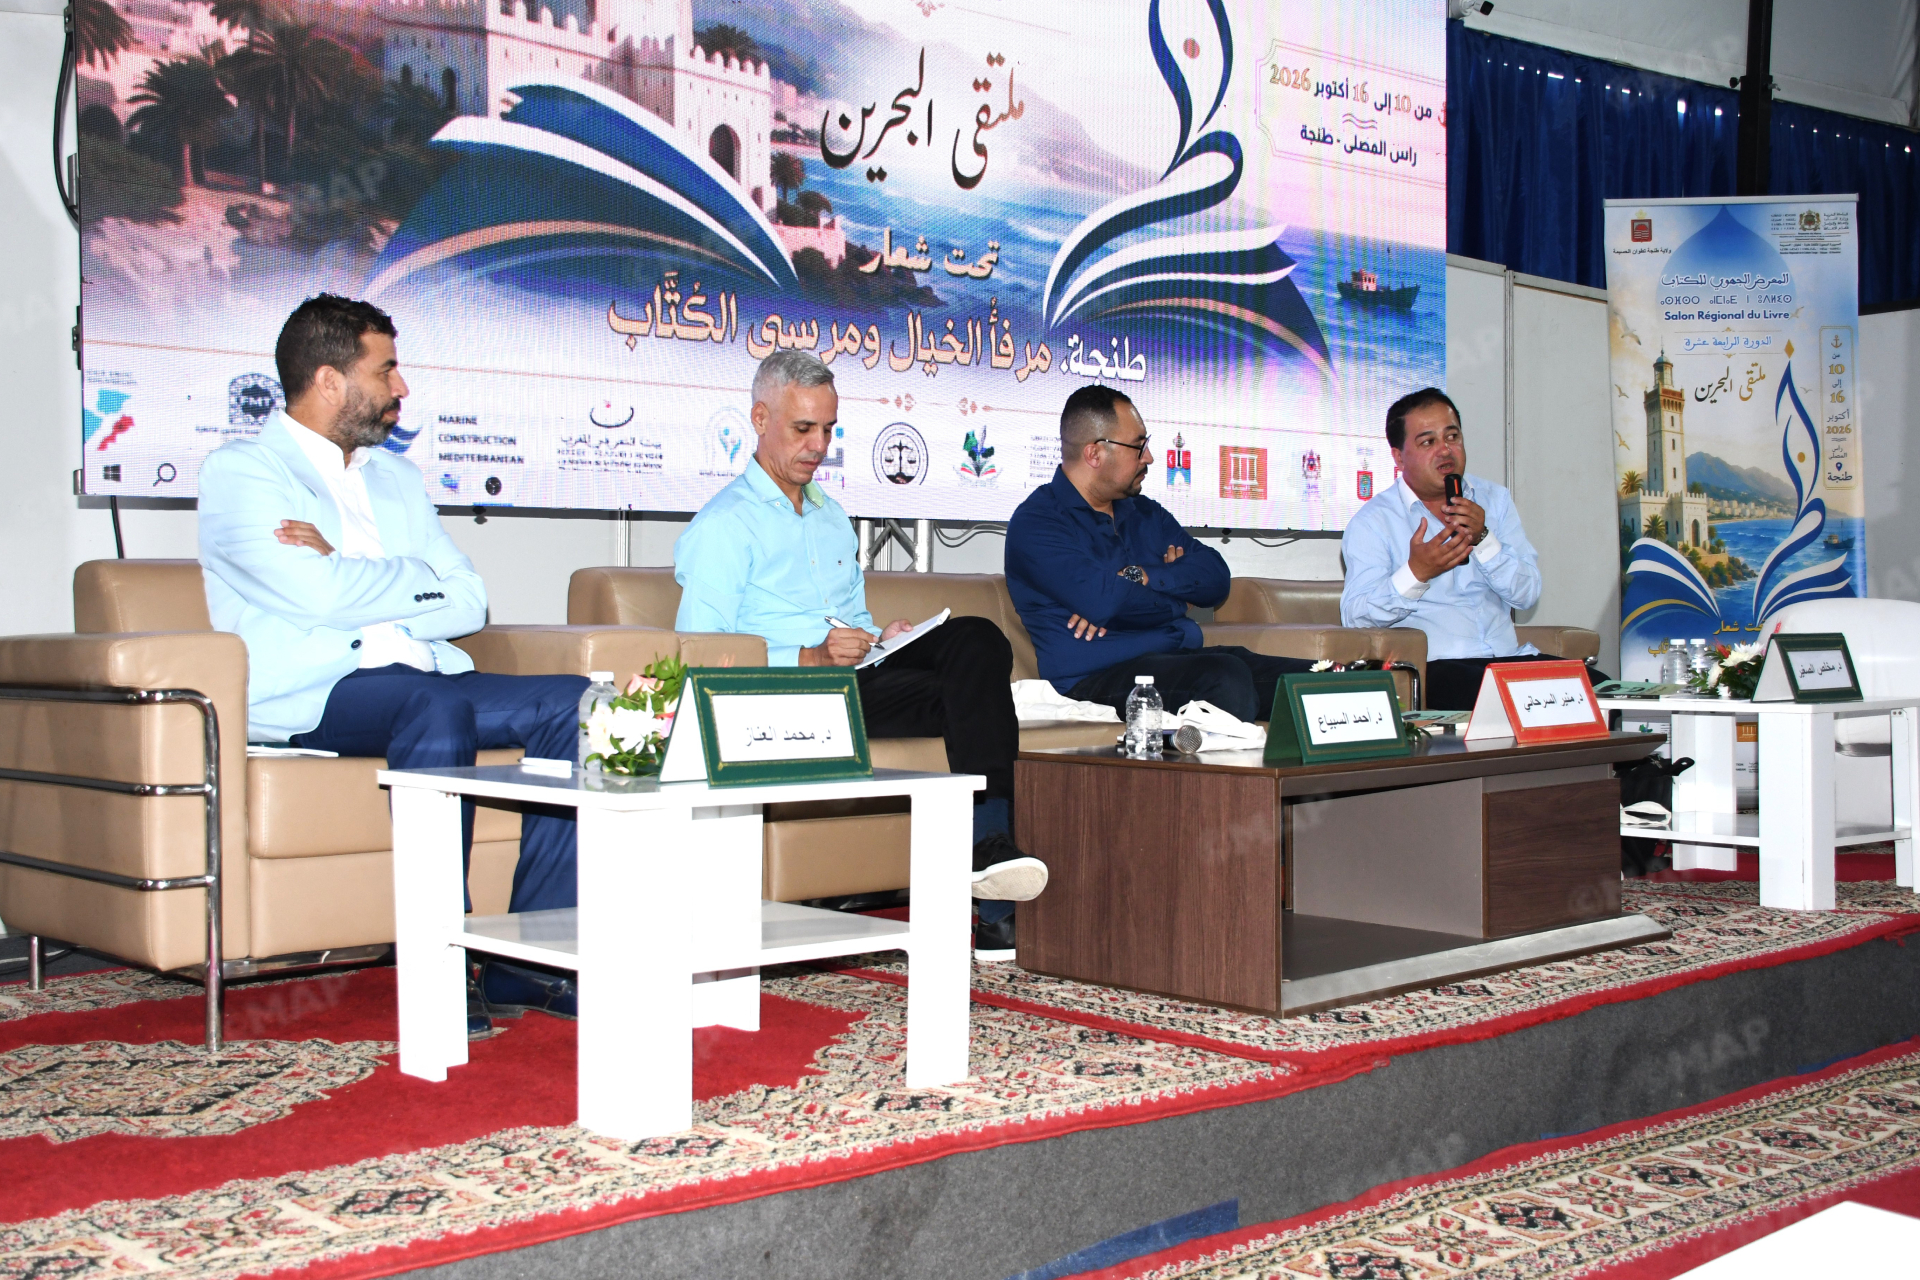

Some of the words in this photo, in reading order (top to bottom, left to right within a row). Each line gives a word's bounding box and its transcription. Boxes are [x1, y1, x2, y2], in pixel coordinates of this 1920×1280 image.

[1269, 63, 1311, 92] 2026
[1313, 77, 1349, 100] أكتوبر
[1353, 81, 1370, 103] 16
[1374, 93, 1391, 115] إلى
[1394, 94, 1412, 113] 10
[820, 46, 933, 183] البحرين
[951, 51, 1025, 190] ملتقى
[1414, 104, 1432, 121] من
[1300, 124, 1334, 146] طنجة
[1343, 134, 1386, 157] المصلى
[858, 226, 932, 274] شعار
[1647, 247, 1660, 255] طنجة
[943, 239, 1000, 279] تحت
[1661, 273, 1707, 287] للكتاب
[1710, 273, 1750, 291] الجهوي
[1744, 272, 1789, 290] المعرض
[1664, 310, 1695, 321] Salon
[1697, 309, 1744, 322] Régional
[1747, 309, 1761, 319] du
[1763, 309, 1790, 319] Livre
[746, 313, 881, 371] ومرسى
[888, 309, 983, 378] الخيال
[1683, 337, 1709, 351] عشرة
[1712, 336, 1740, 351] الرابعة
[1743, 335, 1772, 350] الدورة
[1828, 363, 1845, 375] 10
[1694, 366, 1733, 404] البحرين
[1739, 362, 1766, 401] ملتقى
[1831, 379, 1842, 389] إلى
[1830, 389, 1846, 404] 16
[438, 414, 478, 426] MARINE
[1826, 408, 1850, 423] أكتوبر
[1825, 423, 1852, 435] 2026
[438, 433, 517, 445] CONSTRUCTION
[1827, 471, 1853, 483] طنجة
[1712, 620, 1740, 635] شعار
[1524, 693, 1558, 712] السرحاني
[1561, 692, 1575, 707] منير
[1353, 706, 1372, 724] أحمد
[1375, 711, 1383, 725] د.
[745, 725, 777, 747] العناز
[783, 730, 816, 741] محمد
[821, 728, 832, 744] د.
